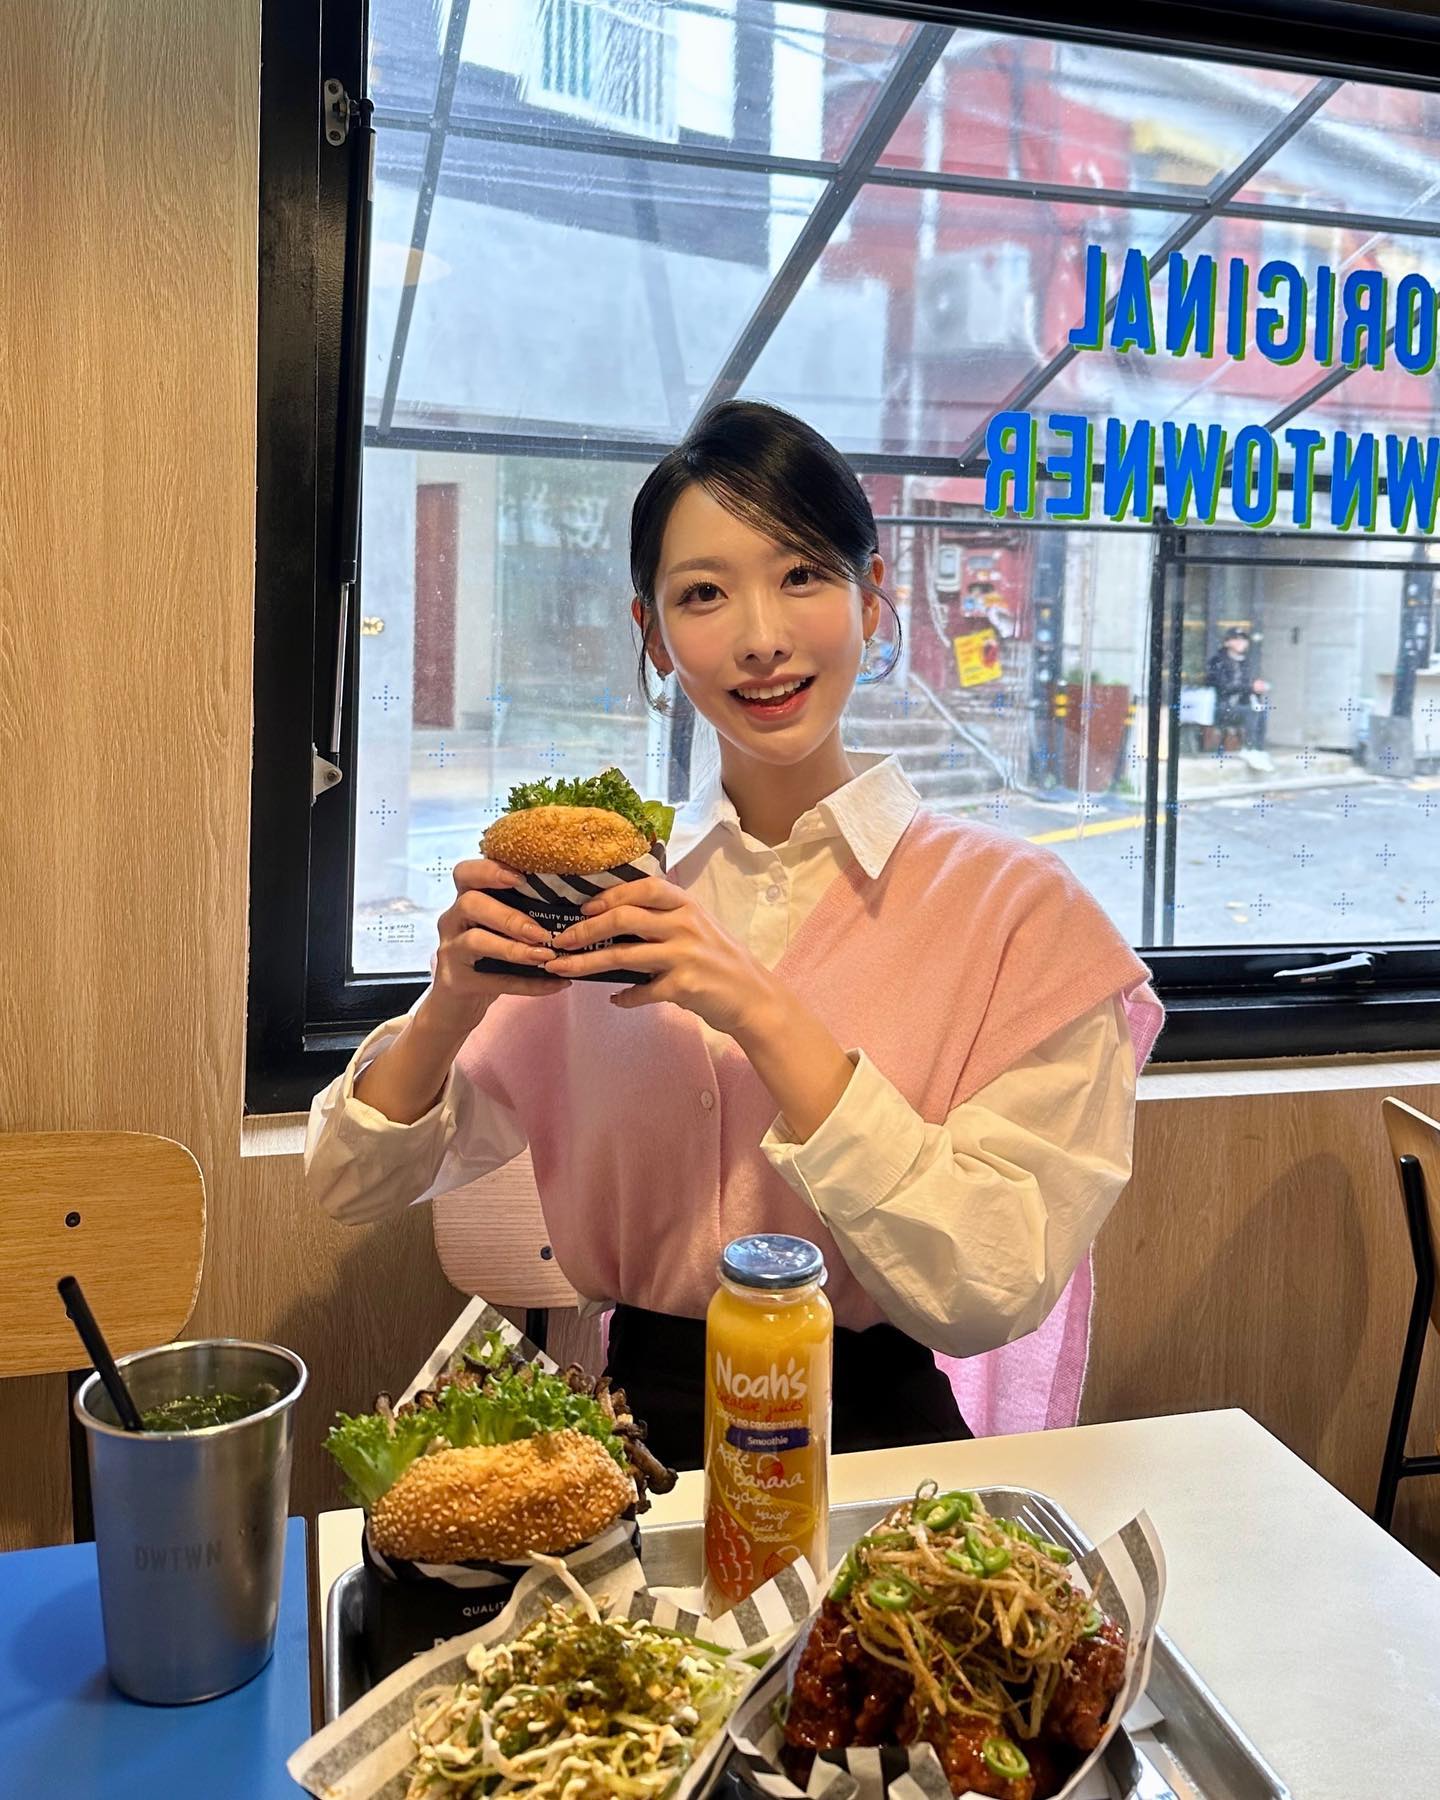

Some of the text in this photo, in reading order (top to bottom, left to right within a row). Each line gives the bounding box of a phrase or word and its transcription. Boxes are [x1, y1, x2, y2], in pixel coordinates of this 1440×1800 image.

[528, 910, 561, 921] QUALITY
[716, 1351, 807, 1401] Noah's
[736, 1418, 749, 1427] no
[749, 1418, 803, 1430] concentrate
[747, 1436, 789, 1446] Smoothie
[716, 1443, 752, 1468] Apple
[732, 1466, 805, 1489] Banana
[755, 1509, 792, 1530] Mango
[134, 1540, 223, 1571] DWTWN
